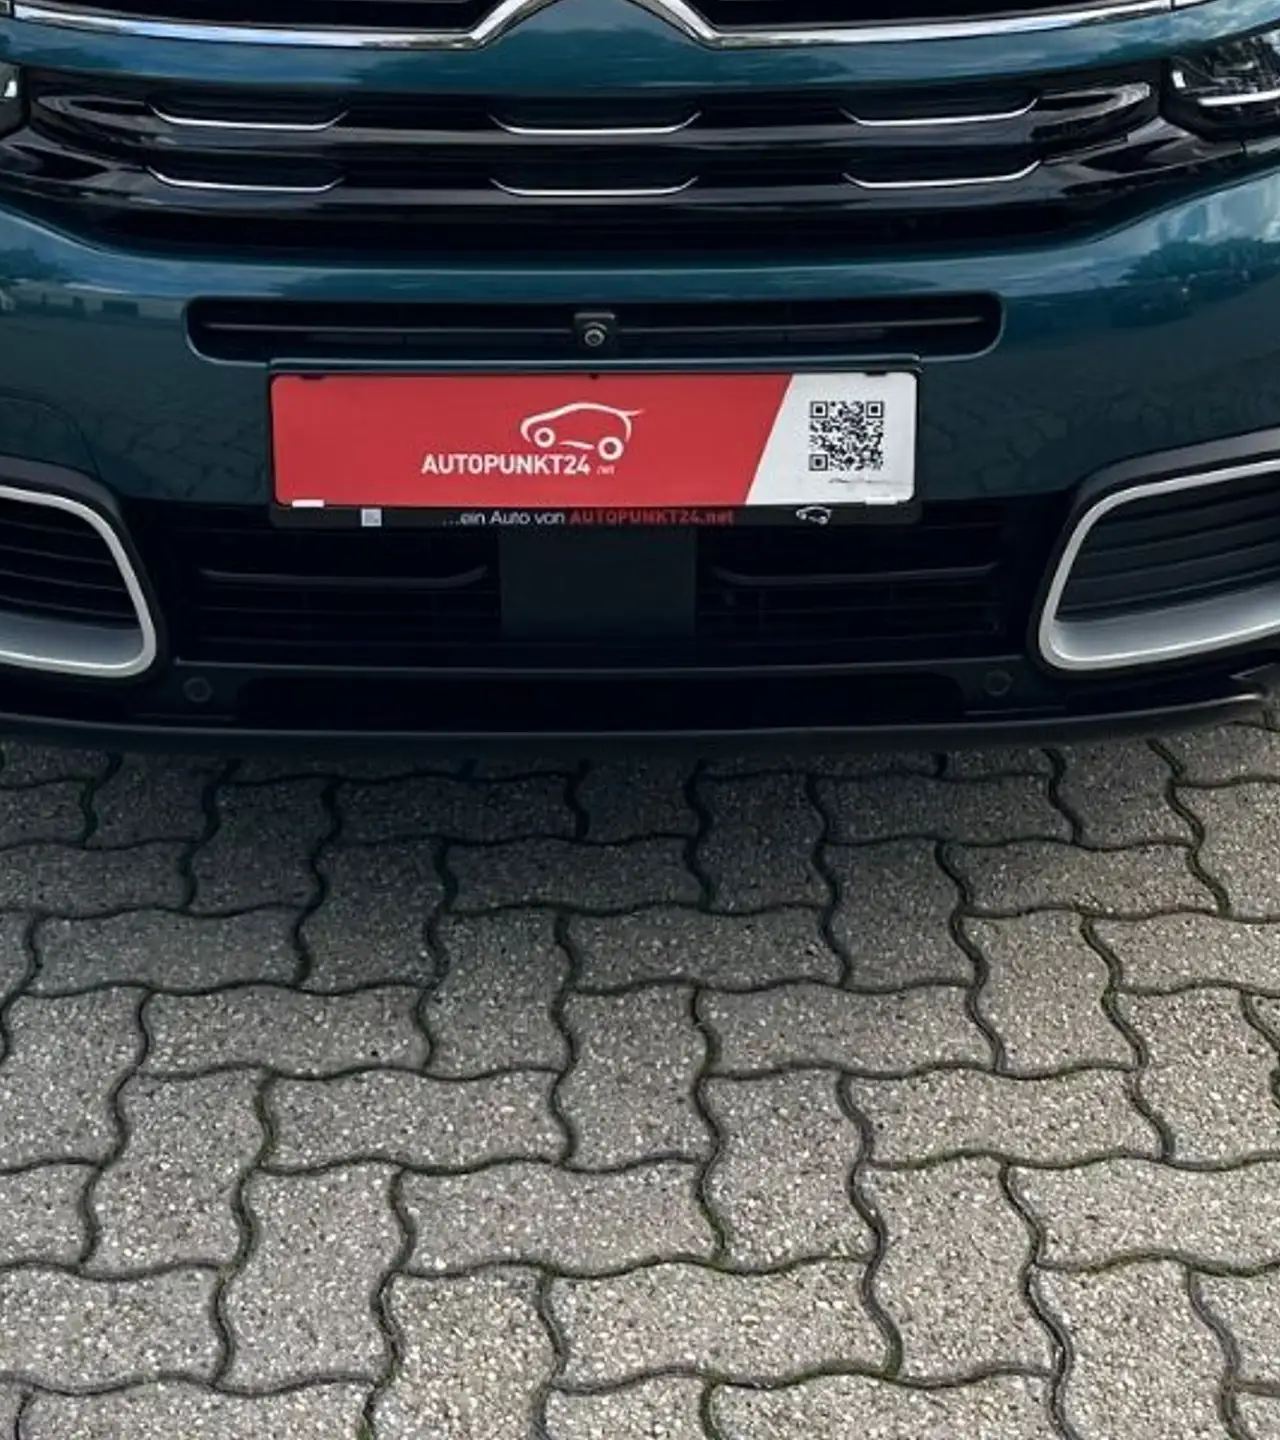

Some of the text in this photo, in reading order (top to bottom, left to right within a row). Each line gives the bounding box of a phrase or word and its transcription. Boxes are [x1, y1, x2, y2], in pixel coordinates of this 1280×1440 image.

[420, 453, 591, 475] AUTOPUNKT24
[489, 510, 531, 526] Auto
[534, 513, 566, 526] von
[568, 509, 734, 526] AUTOPUNKT24.net
